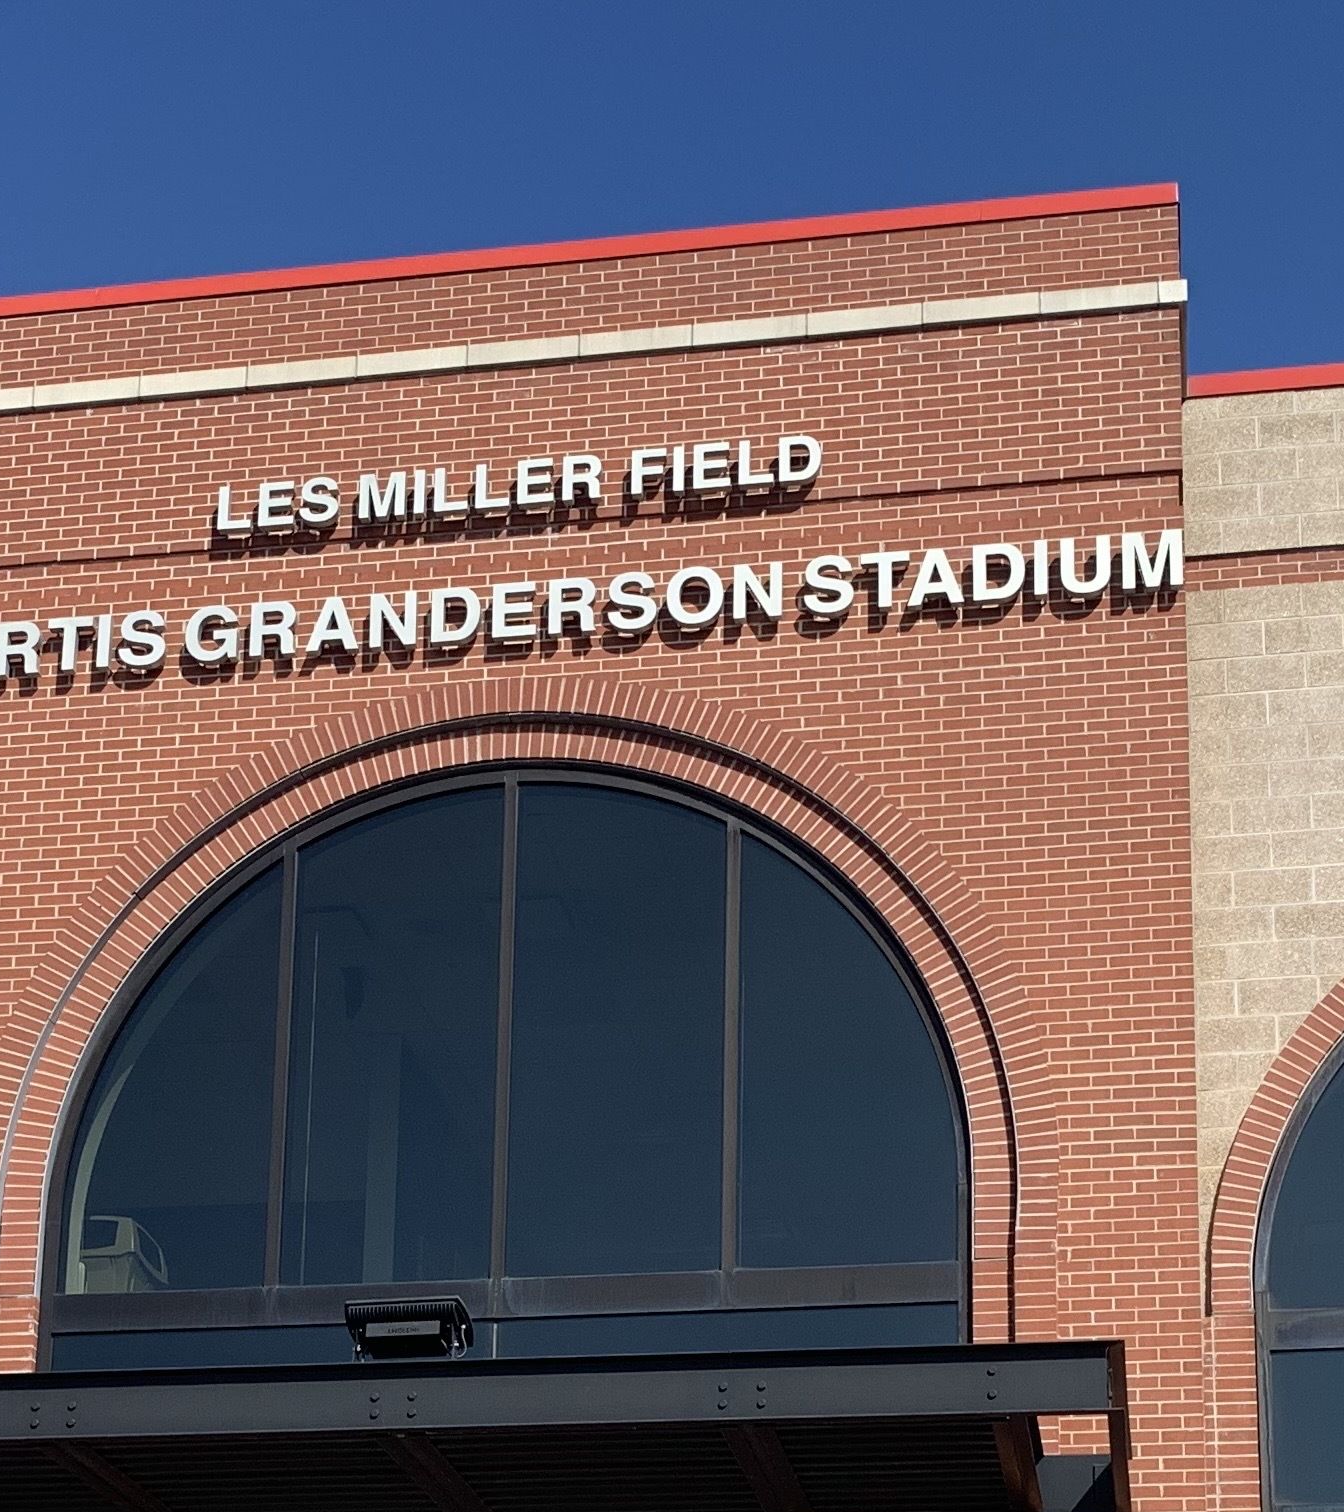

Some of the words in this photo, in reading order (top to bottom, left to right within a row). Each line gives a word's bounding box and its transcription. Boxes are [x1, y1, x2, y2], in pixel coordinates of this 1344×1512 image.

[216, 476, 340, 534] LES
[358, 454, 603, 522] MILLER
[630, 435, 823, 496] FIELD
[184, 562, 784, 663] GRANDERSON
[803, 528, 1185, 614] STADIUM
